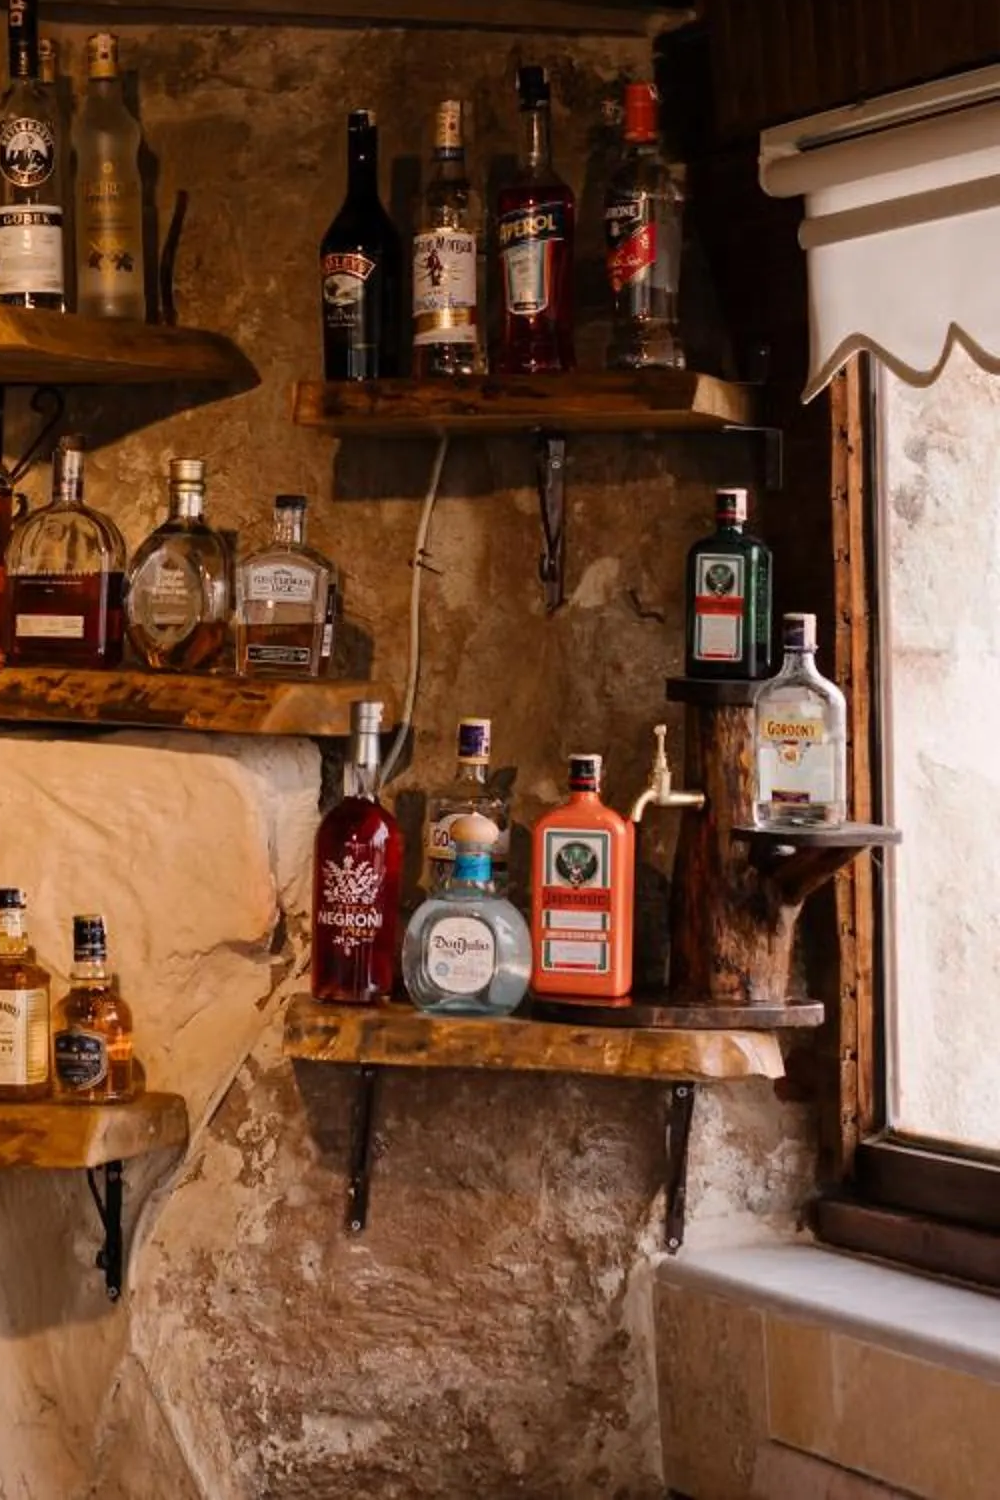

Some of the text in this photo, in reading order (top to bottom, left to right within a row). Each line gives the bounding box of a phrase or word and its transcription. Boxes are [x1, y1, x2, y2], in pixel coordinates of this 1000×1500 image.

[500, 214, 556, 243] APEROL
[318, 911, 382, 928] NEGRONI
[434, 935, 458, 949] Don
